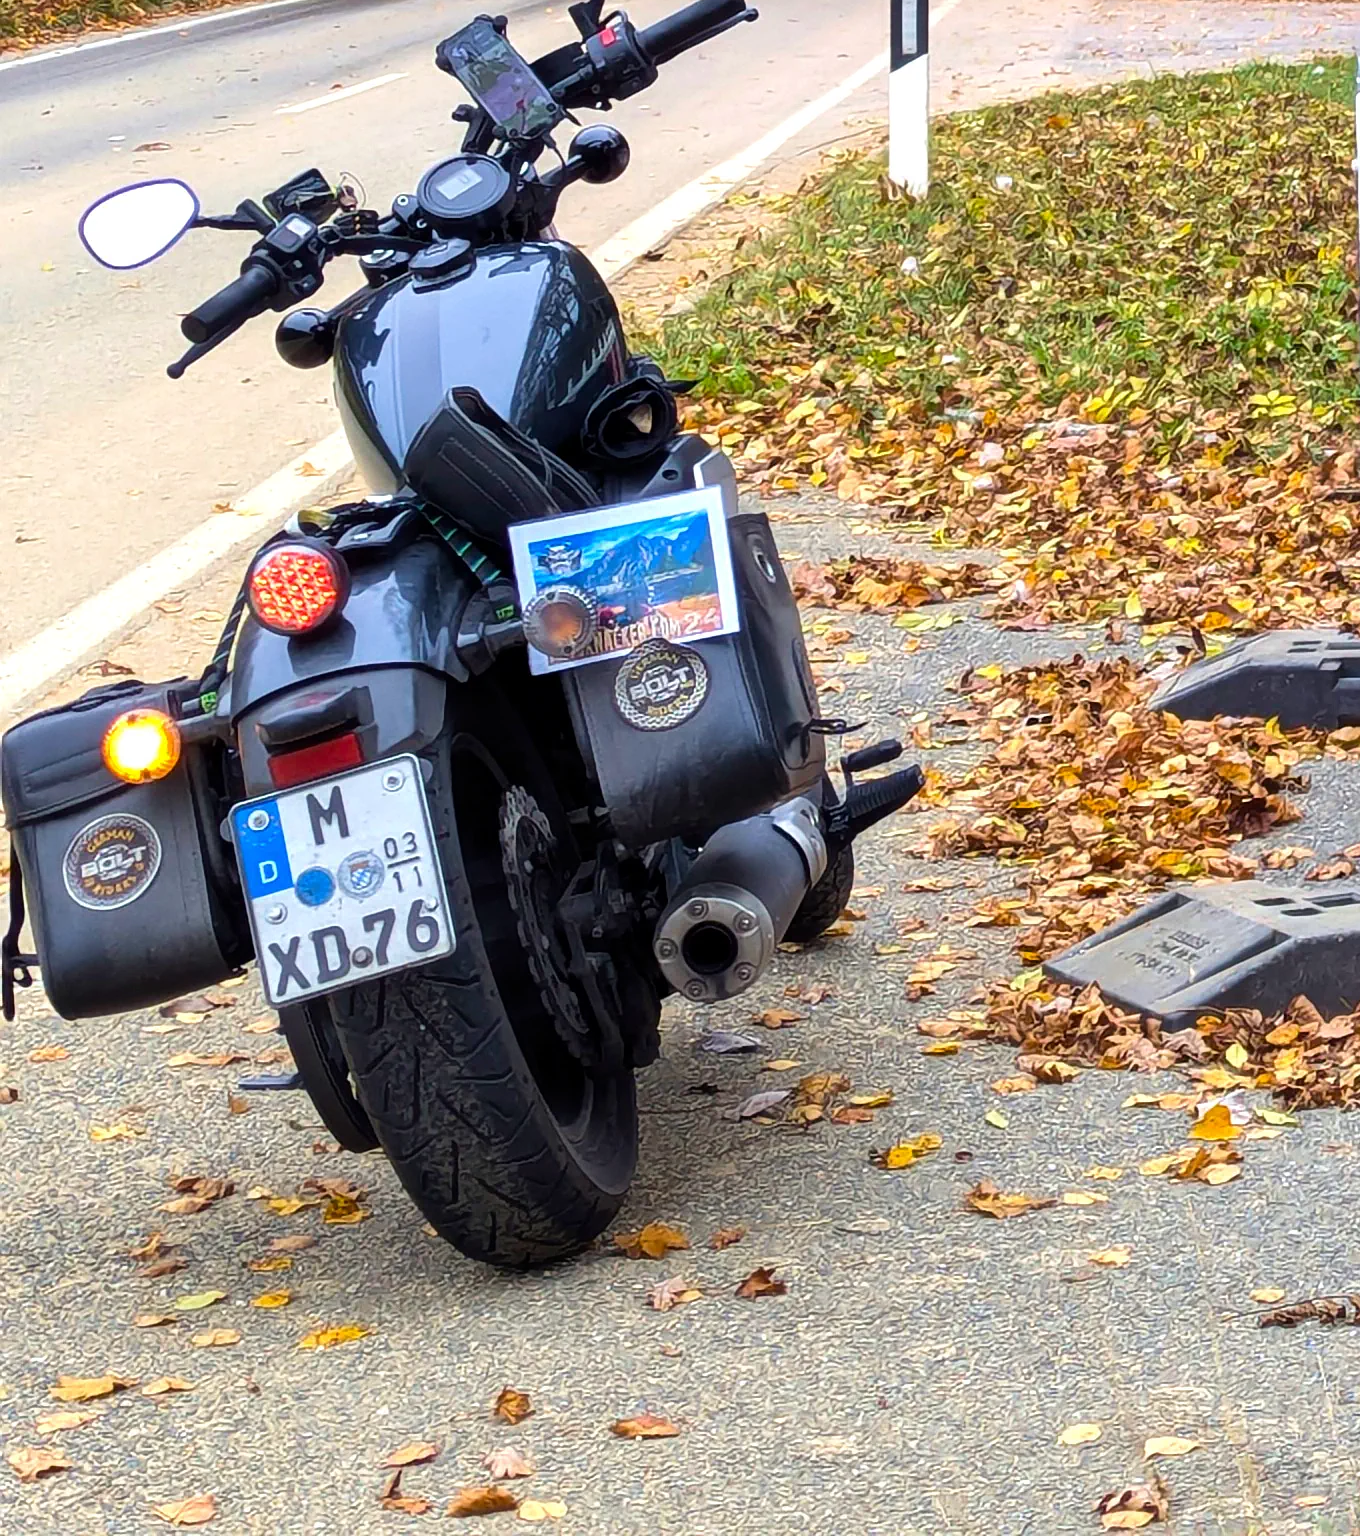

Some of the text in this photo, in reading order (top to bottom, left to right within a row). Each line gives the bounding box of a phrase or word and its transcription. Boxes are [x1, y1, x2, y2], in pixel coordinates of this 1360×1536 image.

[630, 666, 691, 701] BOLT
[306, 785, 350, 846] M
[86, 829, 135, 853] GERMAN
[383, 832, 418, 859] 03
[80, 846, 147, 878] BOLT
[258, 860, 279, 884] D
[392, 865, 423, 893] 11
